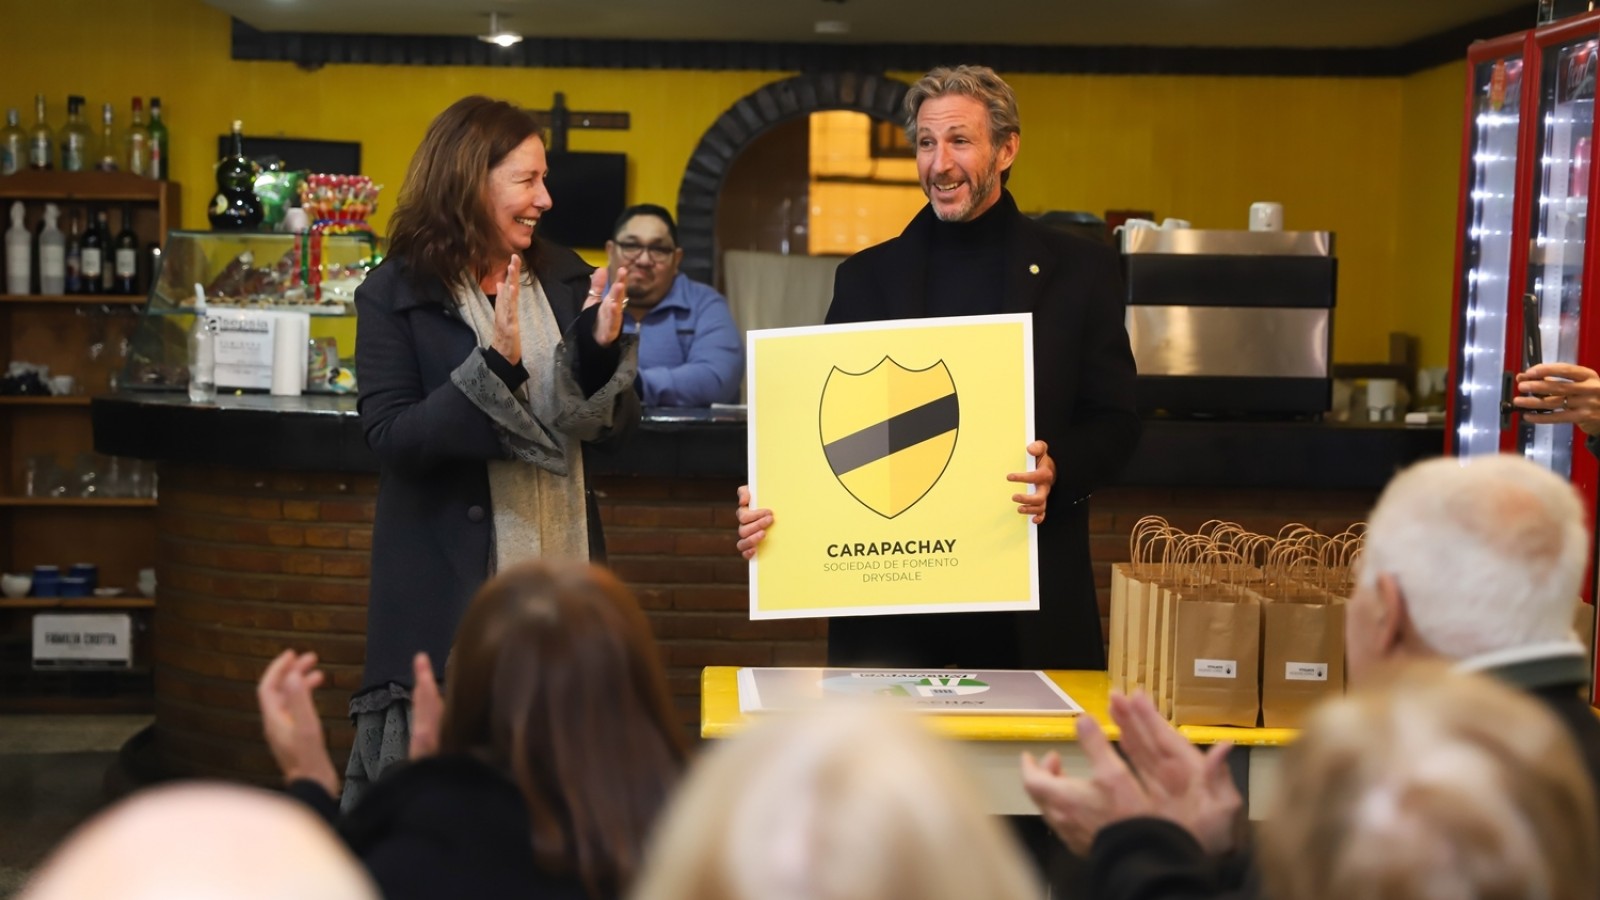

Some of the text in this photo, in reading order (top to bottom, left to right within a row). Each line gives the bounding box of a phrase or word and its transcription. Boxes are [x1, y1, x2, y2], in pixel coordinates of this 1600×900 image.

[827, 539, 957, 558] CARAPACHAY
[823, 557, 959, 572] SOCIEDAD DE FOMENTO
[862, 571, 922, 583] DRYSDALE
